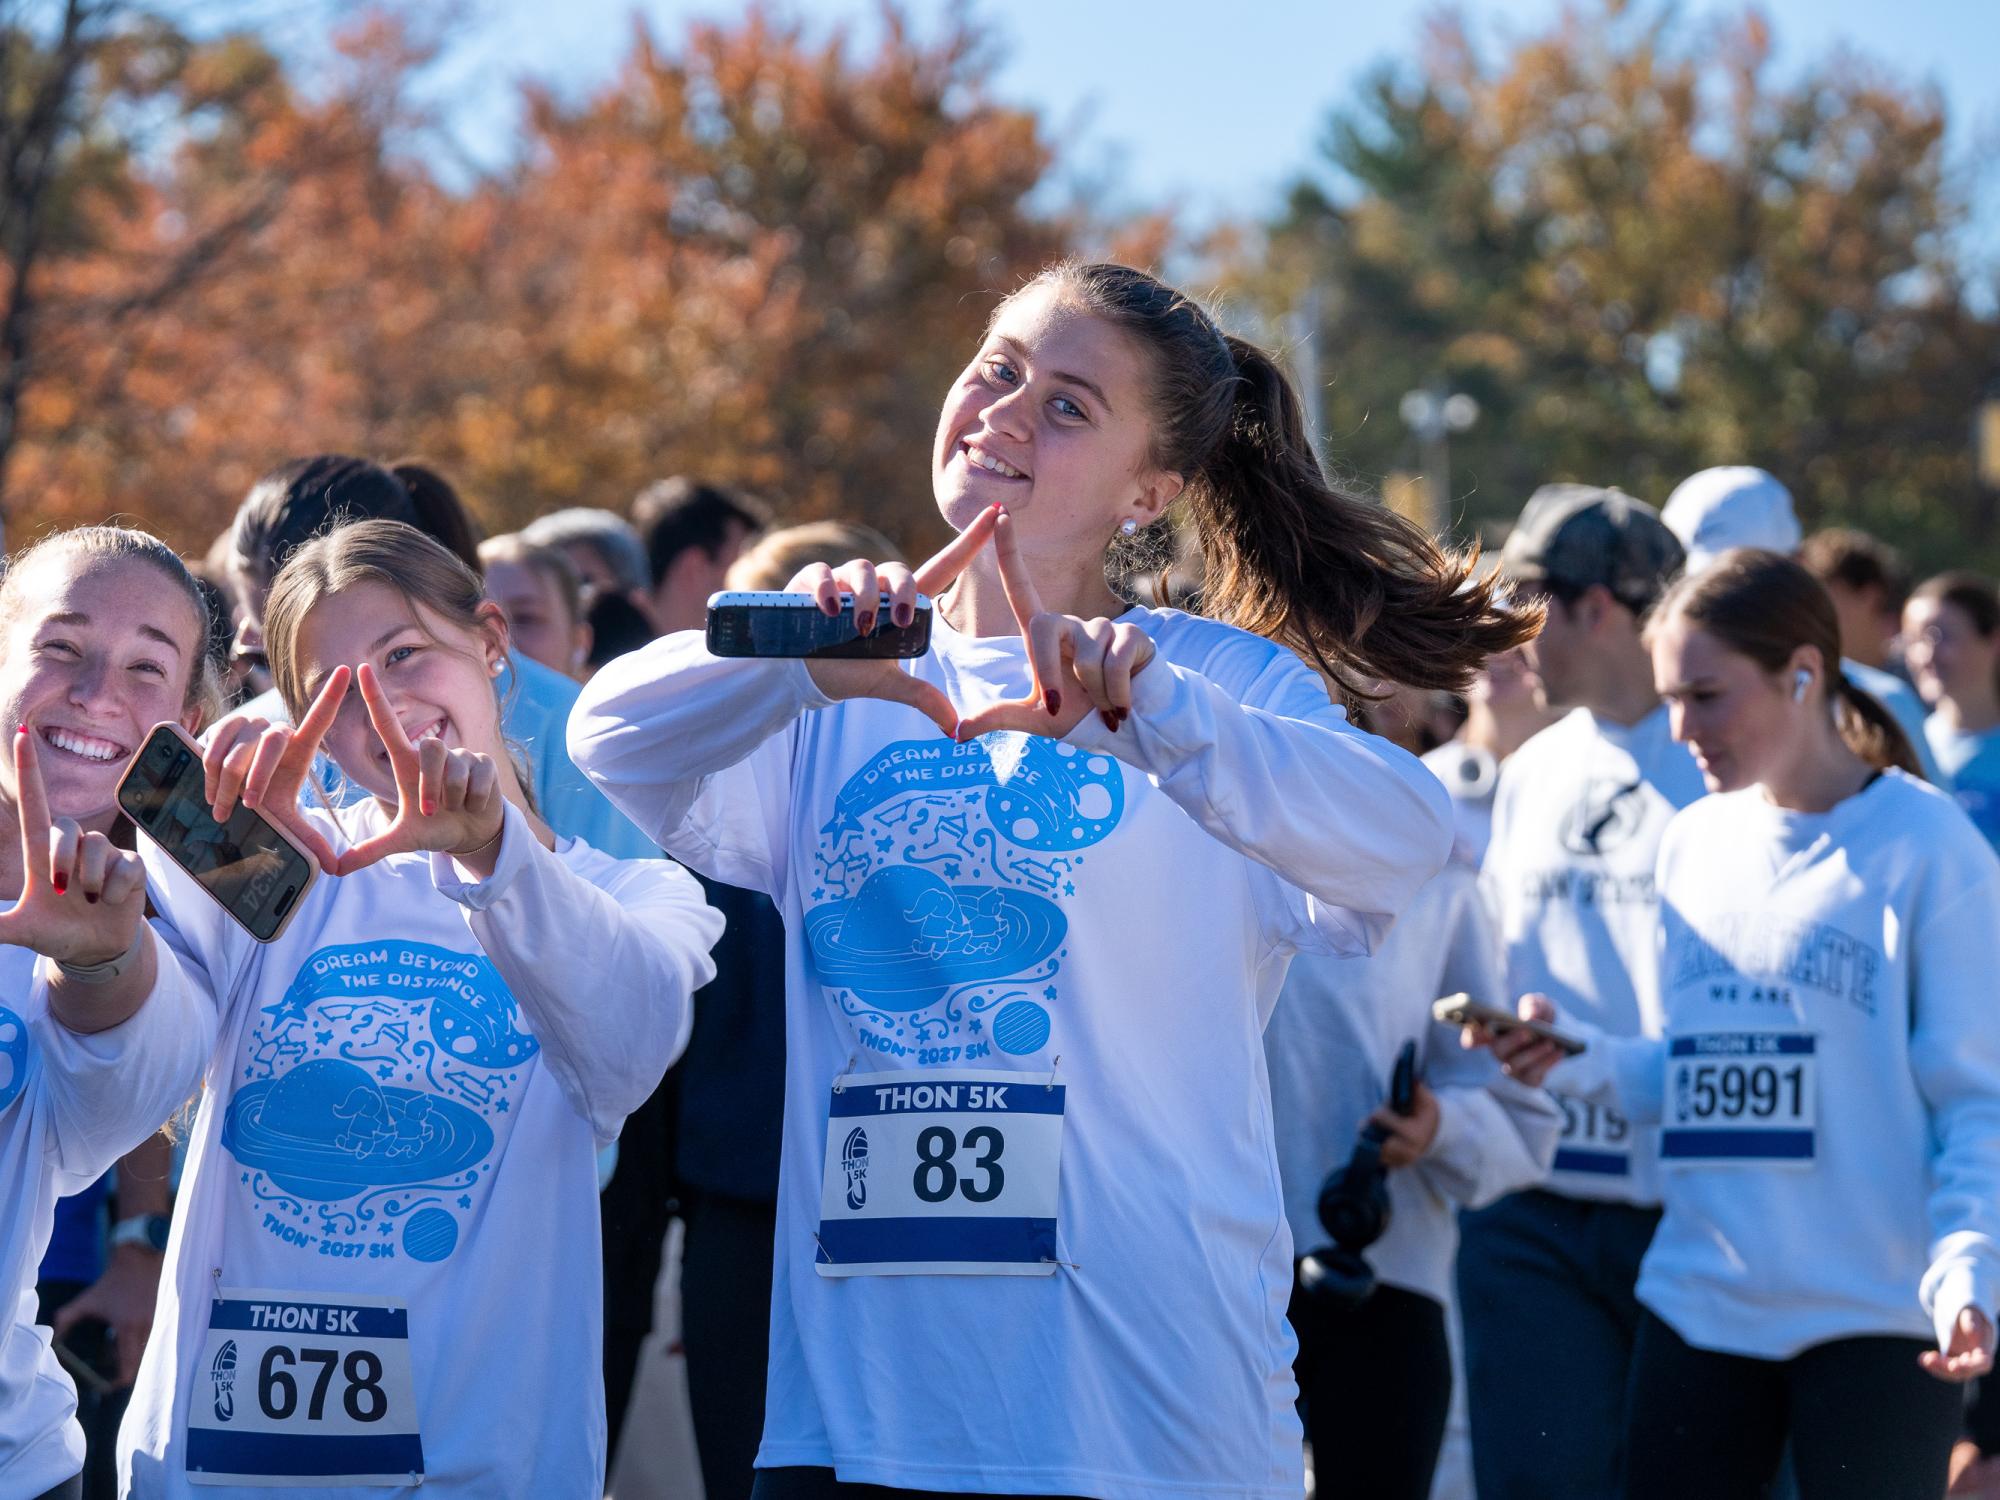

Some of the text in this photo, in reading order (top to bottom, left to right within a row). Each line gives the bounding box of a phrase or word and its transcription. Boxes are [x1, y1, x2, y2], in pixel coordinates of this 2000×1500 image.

[864, 747, 940, 785] DREAM
[892, 763, 1042, 786] THE DISTACE
[313, 949, 479, 978] DREAM BEYOND
[340, 973, 487, 1009] THE DISTANCE
[918, 1046, 961, 1065] 2027
[965, 1040, 990, 1060] 5K
[967, 1086, 1009, 1109] 5K
[1694, 1064, 1803, 1118] 5991
[841, 1157, 869, 1171] THON
[853, 1168, 867, 1180] 5K
[913, 1125, 1005, 1203] 83
[318, 1239, 365, 1257] 2027
[369, 1242, 395, 1258] 5K
[325, 1309, 360, 1333] 5K
[210, 1369, 236, 1381] THON
[220, 1381, 234, 1392] 5K
[258, 1345, 388, 1423] 678
